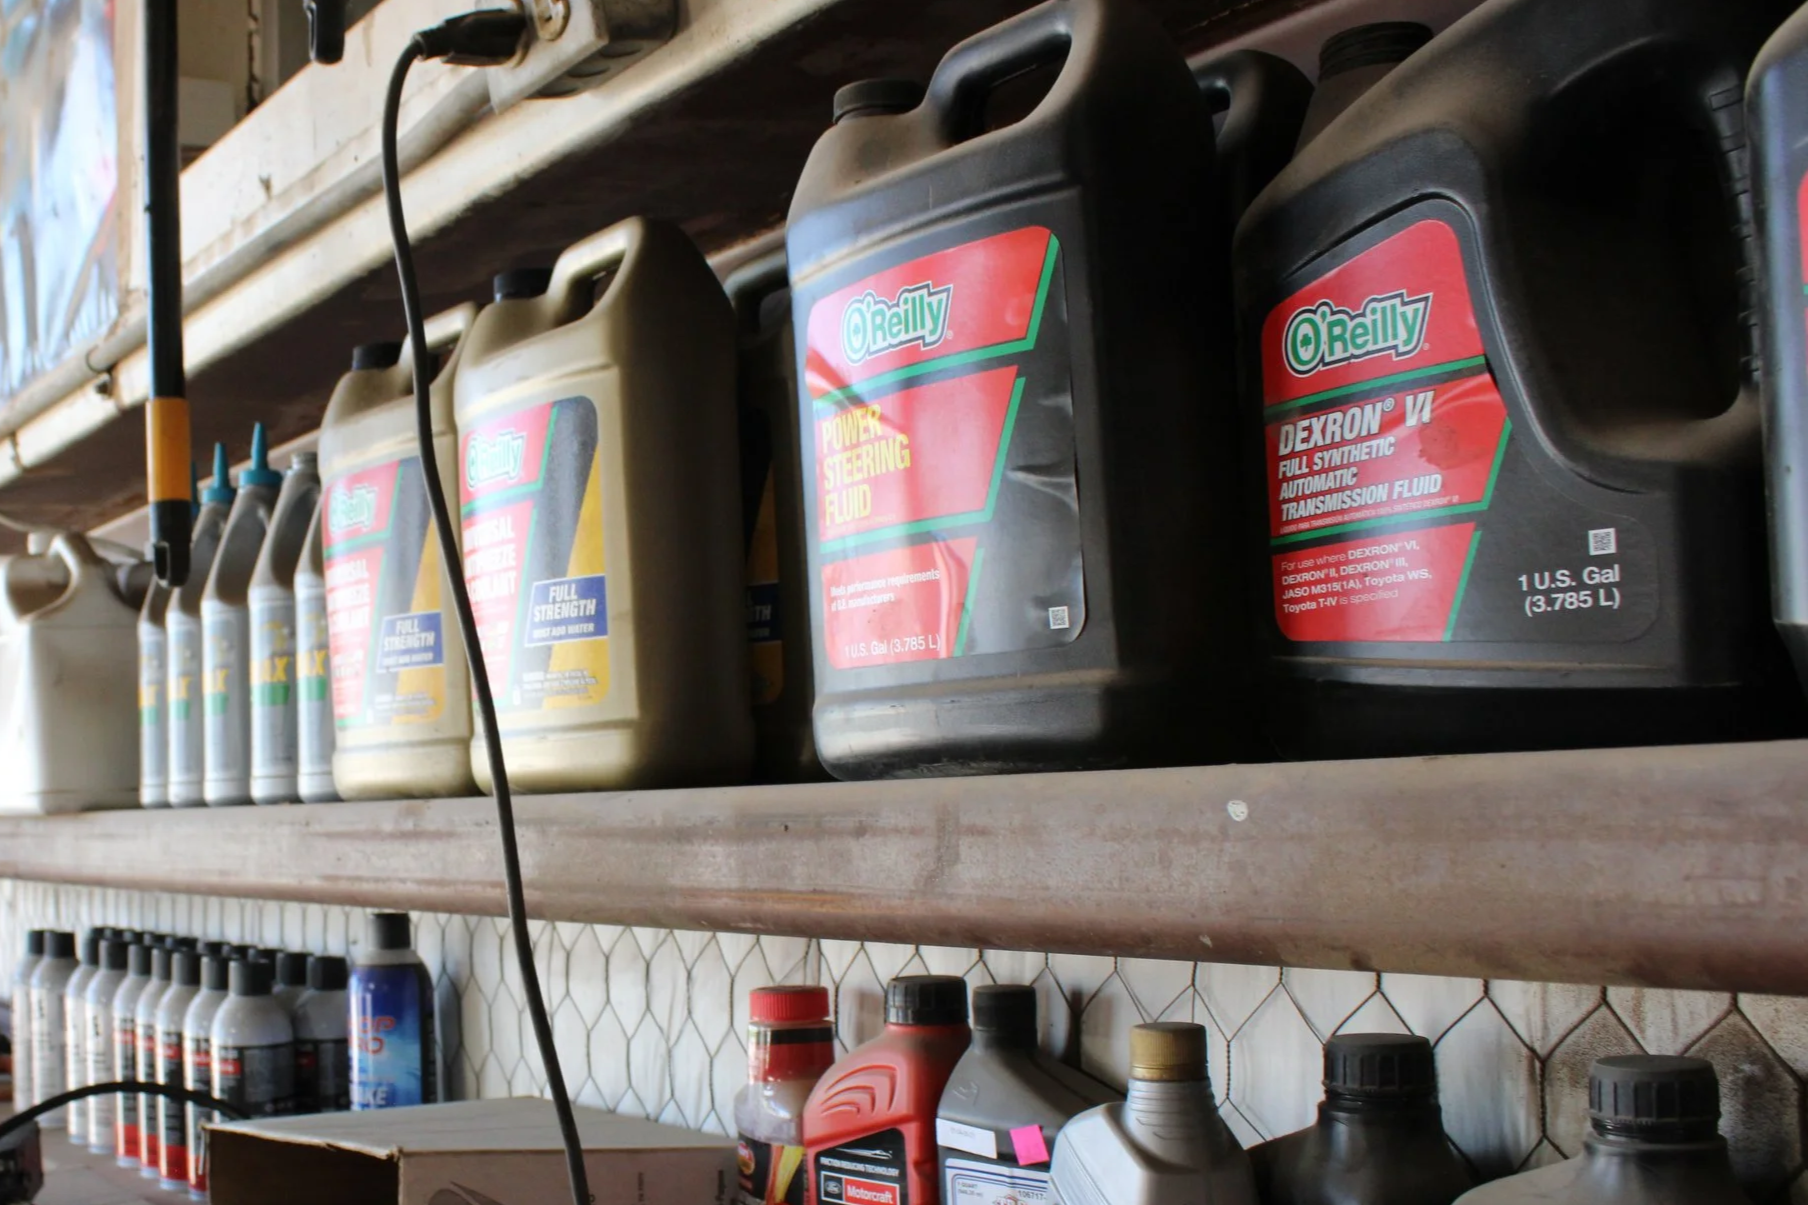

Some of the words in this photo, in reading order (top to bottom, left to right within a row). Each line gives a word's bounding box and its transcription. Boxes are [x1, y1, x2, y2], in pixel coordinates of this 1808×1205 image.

[842, 290, 947, 359] O'Reilly
[1287, 297, 1426, 373] O'Reilly
[1405, 390, 1435, 427] VI
[822, 404, 881, 454] POWER
[823, 434, 911, 490] STEERING
[1278, 456, 1310, 479] FULL
[1313, 436, 1396, 471] SYNTHETIC
[1279, 467, 1358, 500] AUTOMATIC
[1281, 483, 1389, 521] TRANSMISSION
[1392, 474, 1442, 500] FLUID
[825, 484, 871, 526] FLUID
[1281, 562, 1296, 571] For
[1298, 559, 1314, 568] use
[1316, 552, 1347, 566] where
[1405, 540, 1420, 550] VI,
[887, 569, 940, 587] requirements
[1282, 586, 1310, 599] JASO
[1311, 579, 1362, 595] M315(1A),
[1364, 573, 1405, 587] Toyota
[1407, 569, 1433, 580] WS,
[1518, 574, 1528, 591] 1
[1533, 569, 1577, 590] U.S.
[1582, 563, 1620, 585] Gal
[549, 583, 578, 603] FULL
[1282, 601, 1317, 614] Toyota
[1318, 597, 1338, 608] T-IV
[1339, 596, 1348, 605] is
[1350, 587, 1399, 605] specified
[1524, 590, 1594, 617] (3.785
[1598, 587, 1620, 609] L)
[534, 598, 597, 622] STRENGTH
[384, 631, 435, 651] STRENGTH
[396, 618, 419, 634] FULL
[850, 642, 869, 658] U.S.
[871, 639, 888, 655] Gal
[890, 635, 926, 656] (3.785
[929, 633, 941, 651] L)
[847, 1184, 894, 1204] Motorcraft
